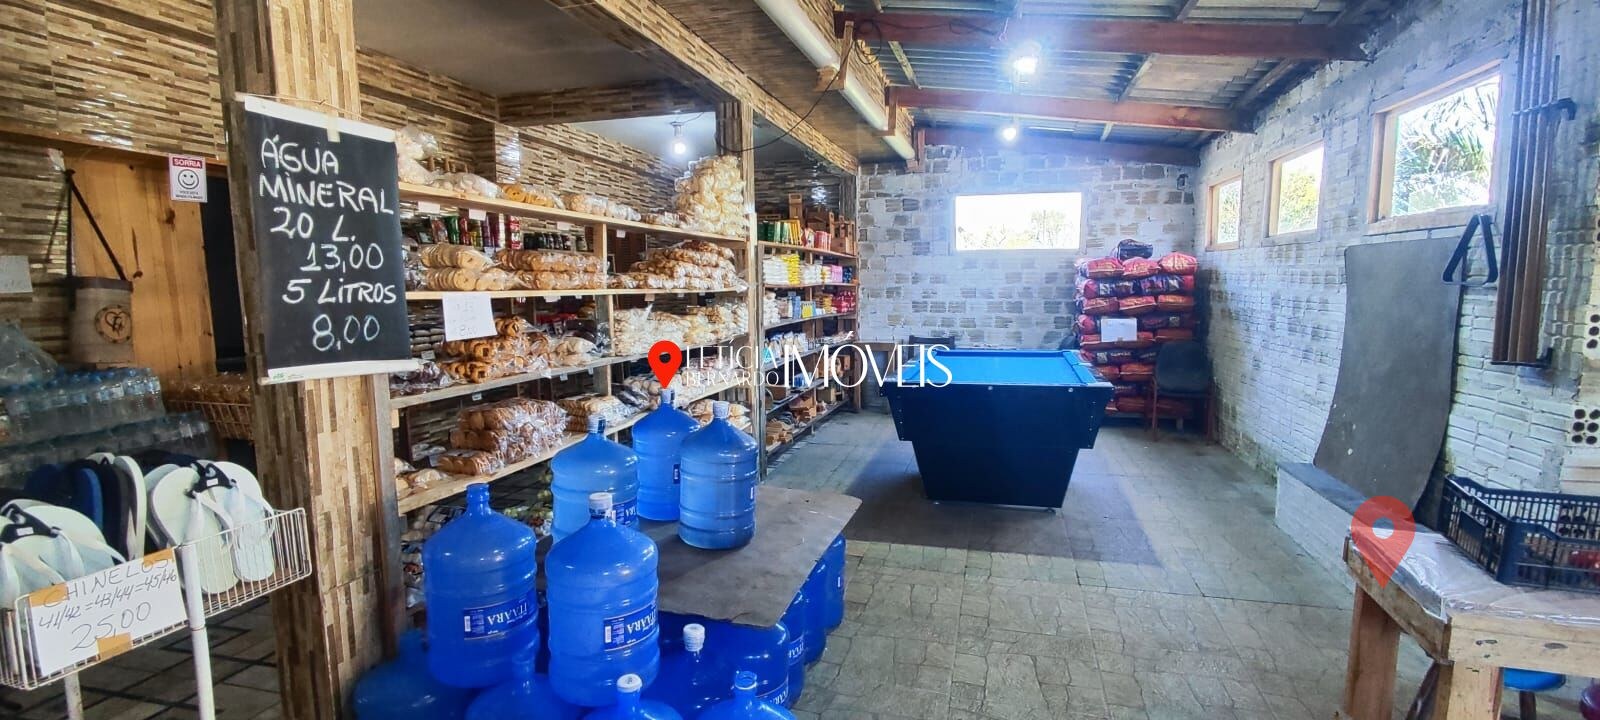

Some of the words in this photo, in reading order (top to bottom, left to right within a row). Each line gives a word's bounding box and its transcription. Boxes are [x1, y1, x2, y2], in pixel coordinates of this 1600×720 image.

[174, 158, 201, 168] SORRIA
[261, 134, 339, 175] ÁGUA
[259, 172, 394, 215] MINERAL
[270, 207, 314, 239] 20
[332, 215, 356, 242] L.
[300, 242, 384, 273] 13,00
[282, 279, 312, 304] 5
[317, 278, 397, 304] LITROS
[312, 314, 380, 351] 8,00
[72, 602, 152, 651] 25,00
